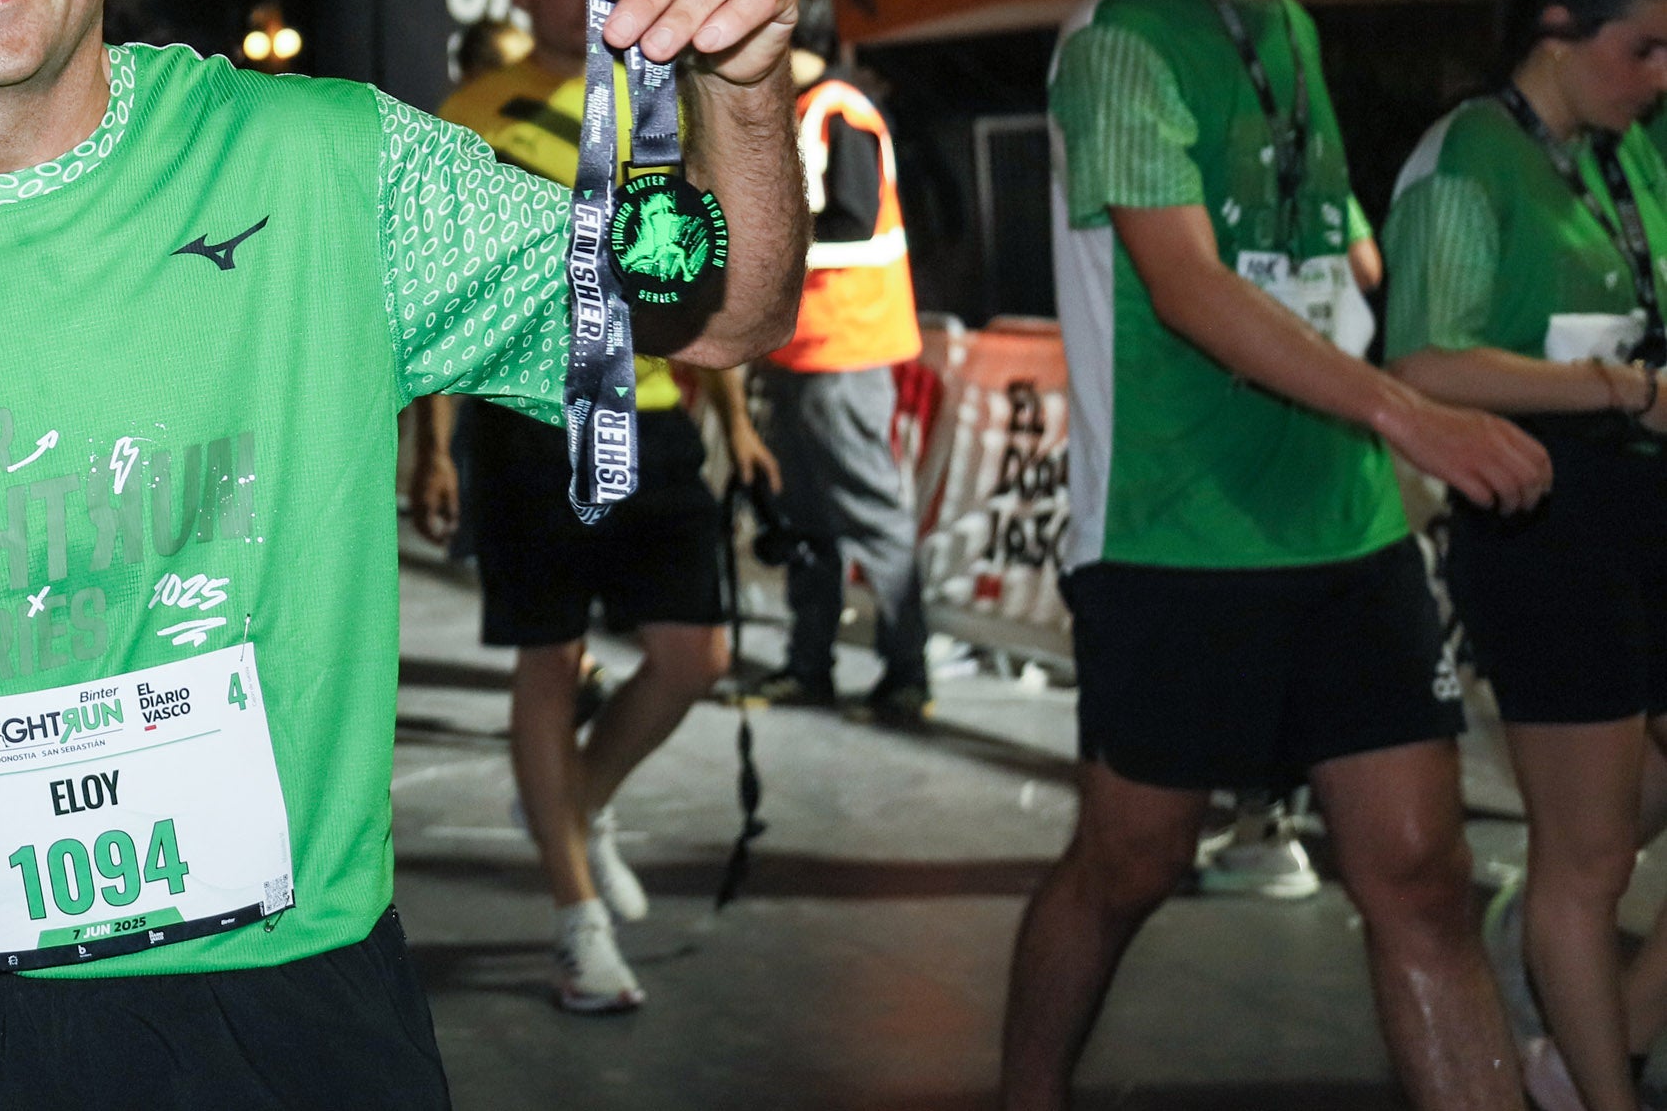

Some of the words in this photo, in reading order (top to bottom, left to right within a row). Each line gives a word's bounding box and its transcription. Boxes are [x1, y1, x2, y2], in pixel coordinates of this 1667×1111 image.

[625, 175, 667, 195] BINTER
[611, 201, 634, 252] FINISHER
[700, 192, 729, 268] NIGHTRUN
[570, 203, 605, 341] FINISHER
[637, 288, 679, 305] SERIES
[148, 573, 230, 610] 2025
[79, 687, 119, 703] Binter
[137, 682, 155, 696] EL
[139, 687, 190, 710] DIARIO
[227, 672, 248, 711] 4
[142, 702, 191, 724] VASCO
[41, 748, 60, 758] SAN
[49, 769, 120, 816] ELOY
[8, 818, 190, 921] 1094
[72, 929, 80, 940] 7
[83, 922, 112, 939] JUN
[114, 916, 147, 933] 2025
